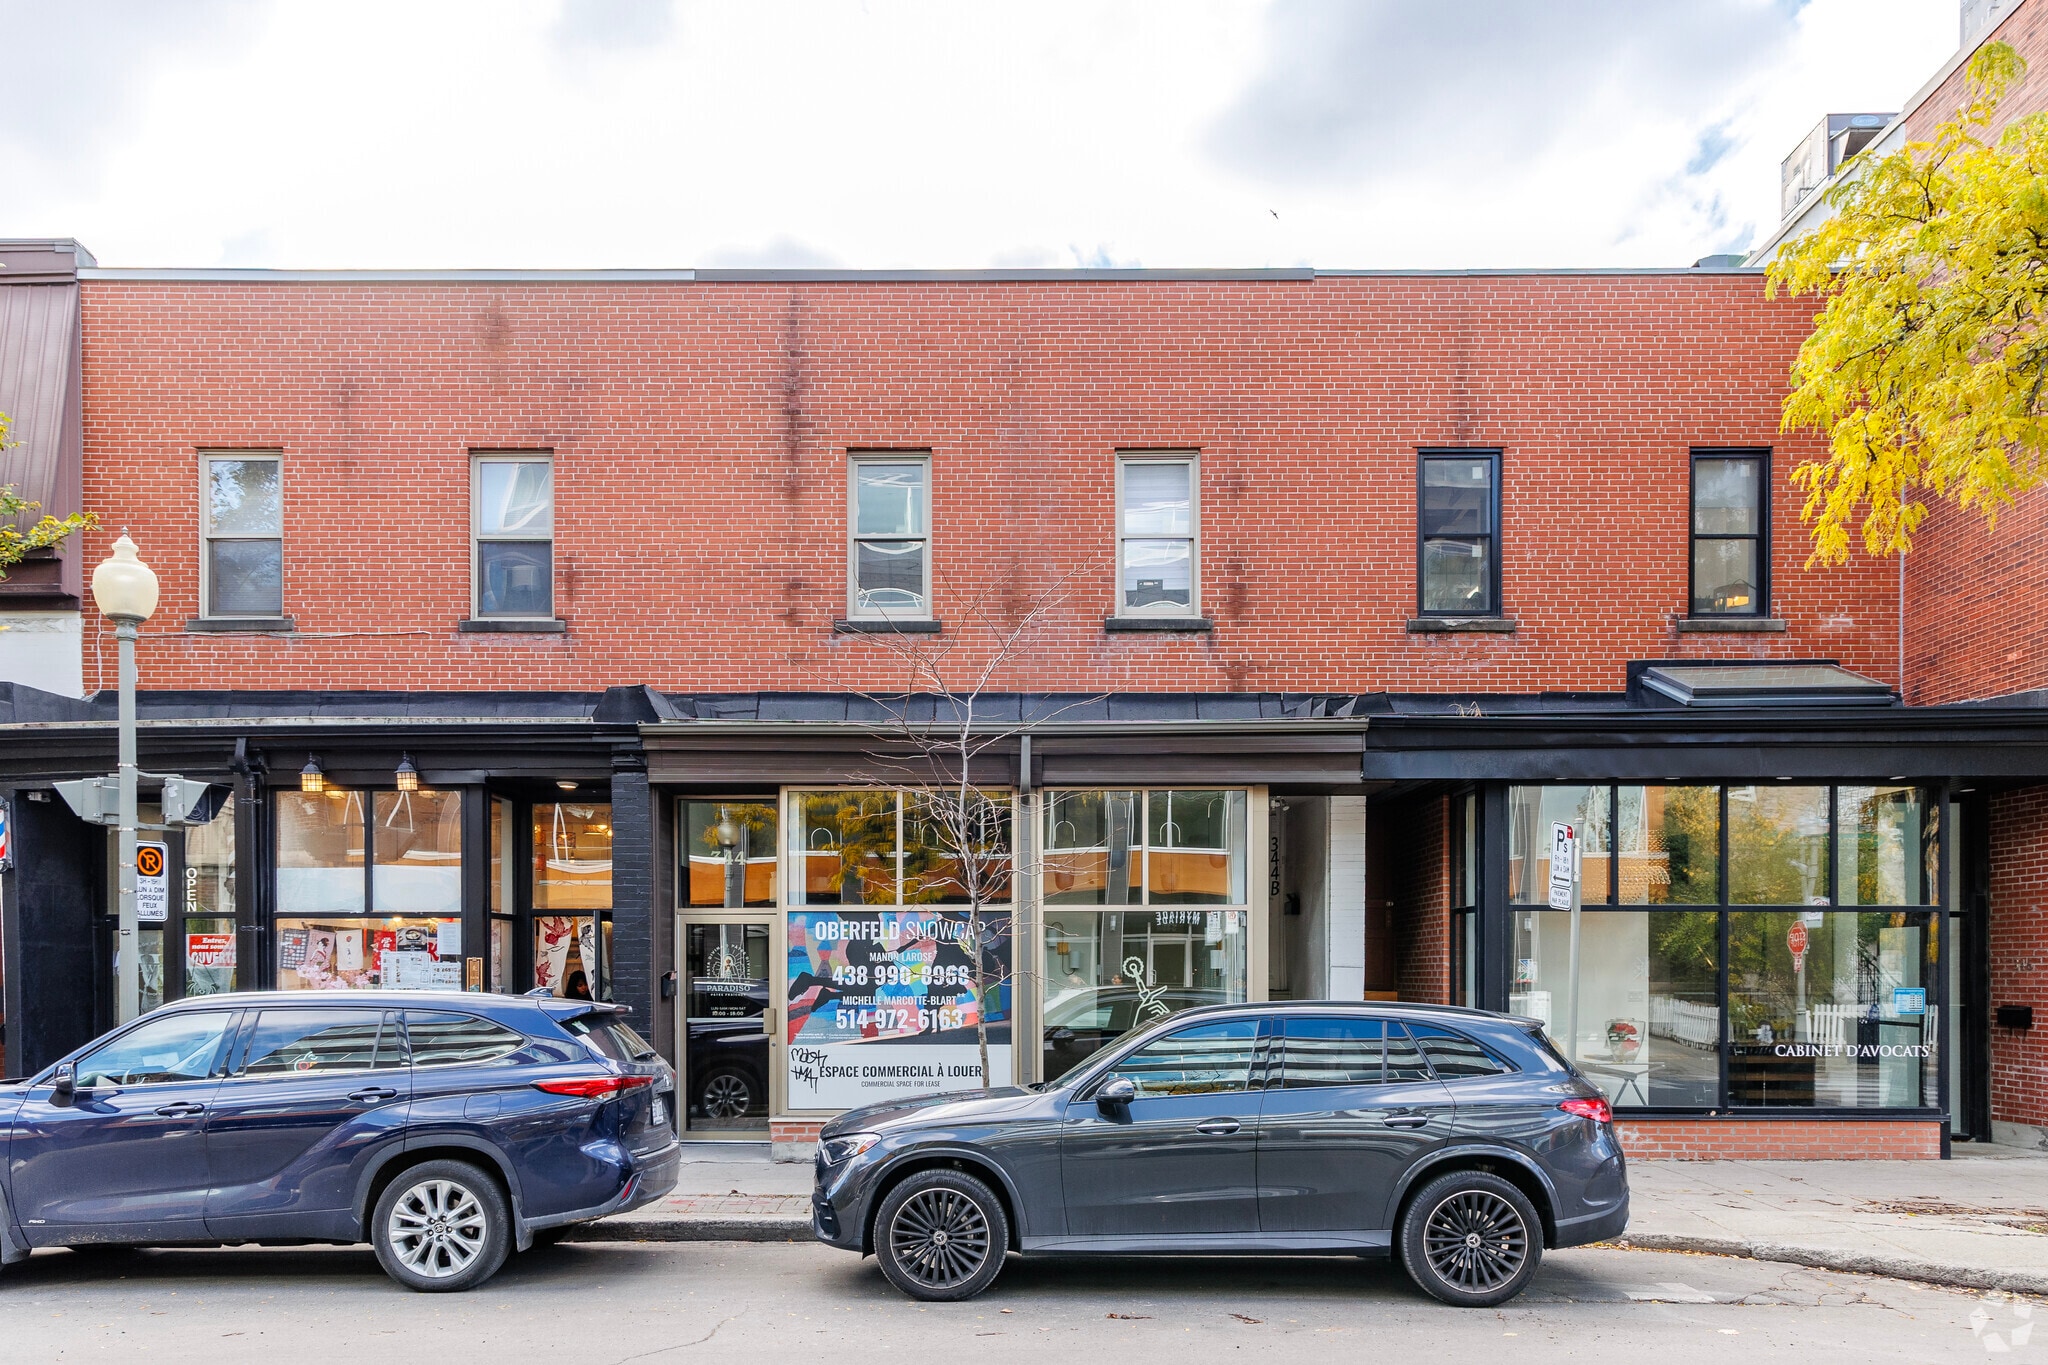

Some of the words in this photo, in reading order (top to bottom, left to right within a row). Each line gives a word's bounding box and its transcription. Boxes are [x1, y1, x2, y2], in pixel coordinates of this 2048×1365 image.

[186, 867, 198, 913] OPEN
[815, 921, 900, 941] OBERFELD
[869, 951, 898, 962] MANON
[832, 965, 868, 986] 438
[842, 995, 882, 1006] MICHELLE
[836, 1008, 869, 1029] 514
[874, 1008, 963, 1029] 972-6163
[1775, 1044, 1843, 1058] CABINET
[1846, 1044, 1930, 1058] D'AVOCATS
[819, 1065, 859, 1078] ESPACE
[862, 1065, 934, 1078] COMMERCIAL
[937, 1062, 944, 1077] À
[947, 1065, 982, 1077] LOUER
[861, 1080, 895, 1088] COMMERCIAL
[896, 1080, 912, 1088] SPACE
[914, 1080, 924, 1088] FOR
[925, 1080, 941, 1088] LEASE
